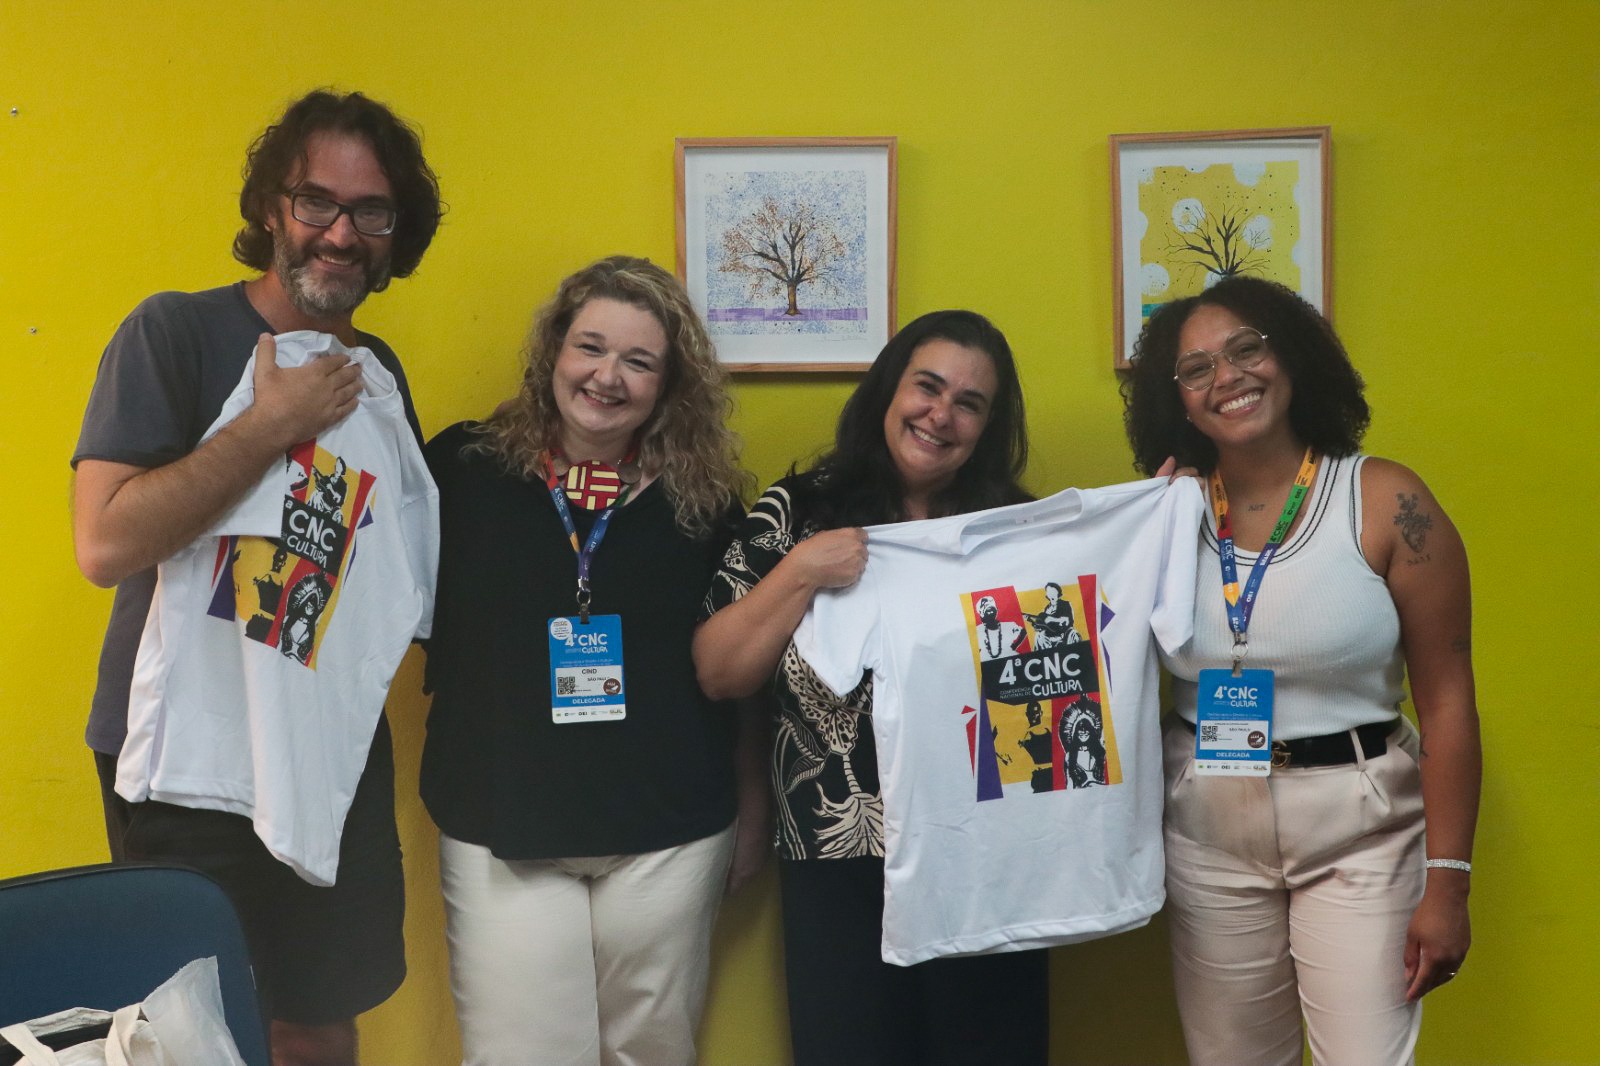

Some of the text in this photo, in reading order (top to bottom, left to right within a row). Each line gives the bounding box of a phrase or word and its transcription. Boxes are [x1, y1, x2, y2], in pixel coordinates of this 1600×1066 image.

[288, 509, 337, 552] CNC
[286, 535, 328, 568] CULTURA
[578, 632, 608, 646] CNC
[582, 646, 608, 654] CULTURA
[1024, 652, 1081, 682] CNC
[1032, 680, 1082, 696] CULTURA
[1228, 686, 1258, 700] CNC
[1230, 700, 1258, 708] CULTURA
